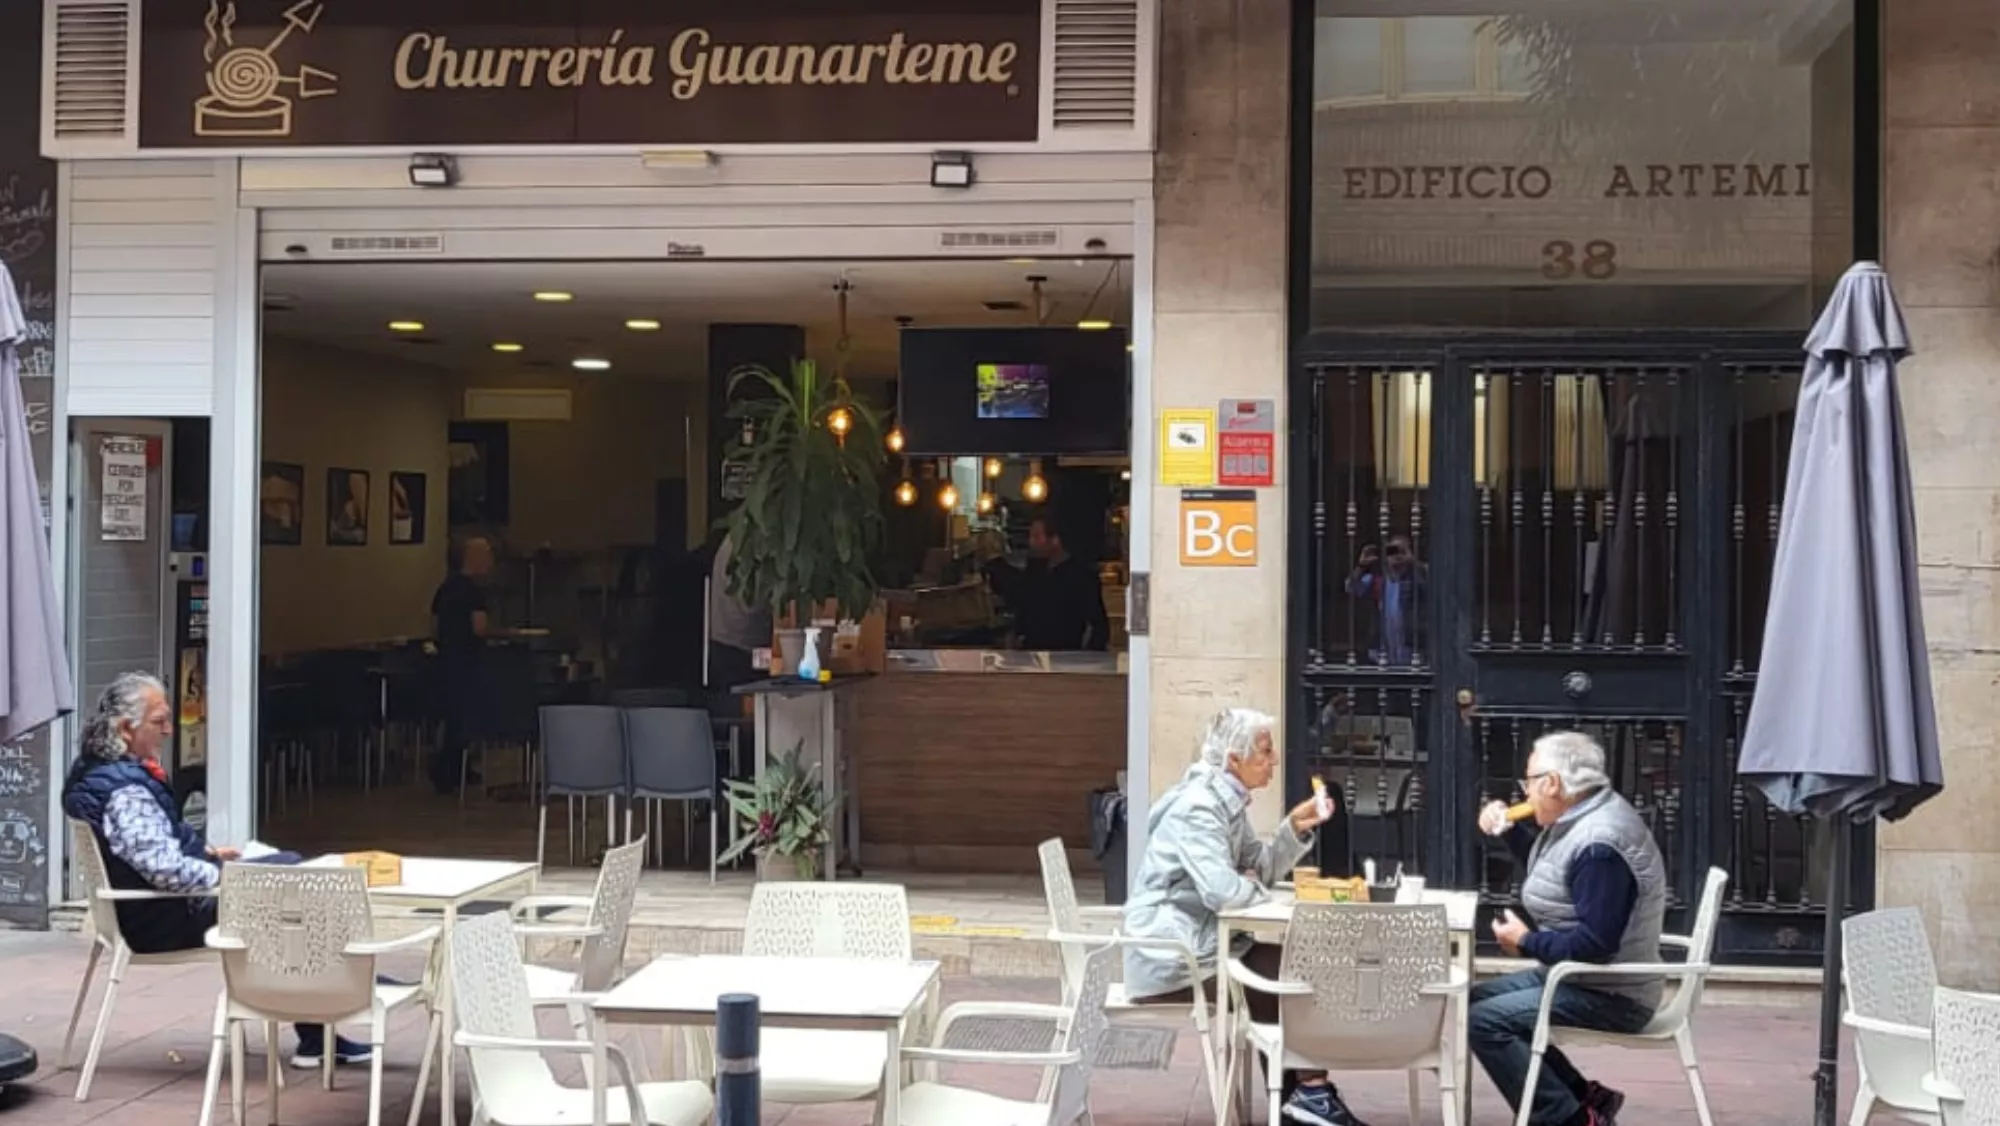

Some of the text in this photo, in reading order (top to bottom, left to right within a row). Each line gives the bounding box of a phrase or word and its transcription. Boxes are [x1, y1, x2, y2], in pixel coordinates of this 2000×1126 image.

[394, 29, 1017, 100] Churrería Guanarteme
[1342, 163, 1811, 199] EDIFICIO ARTEMI
[1541, 239, 1617, 280] 38
[1185, 509, 1255, 558] Bc
